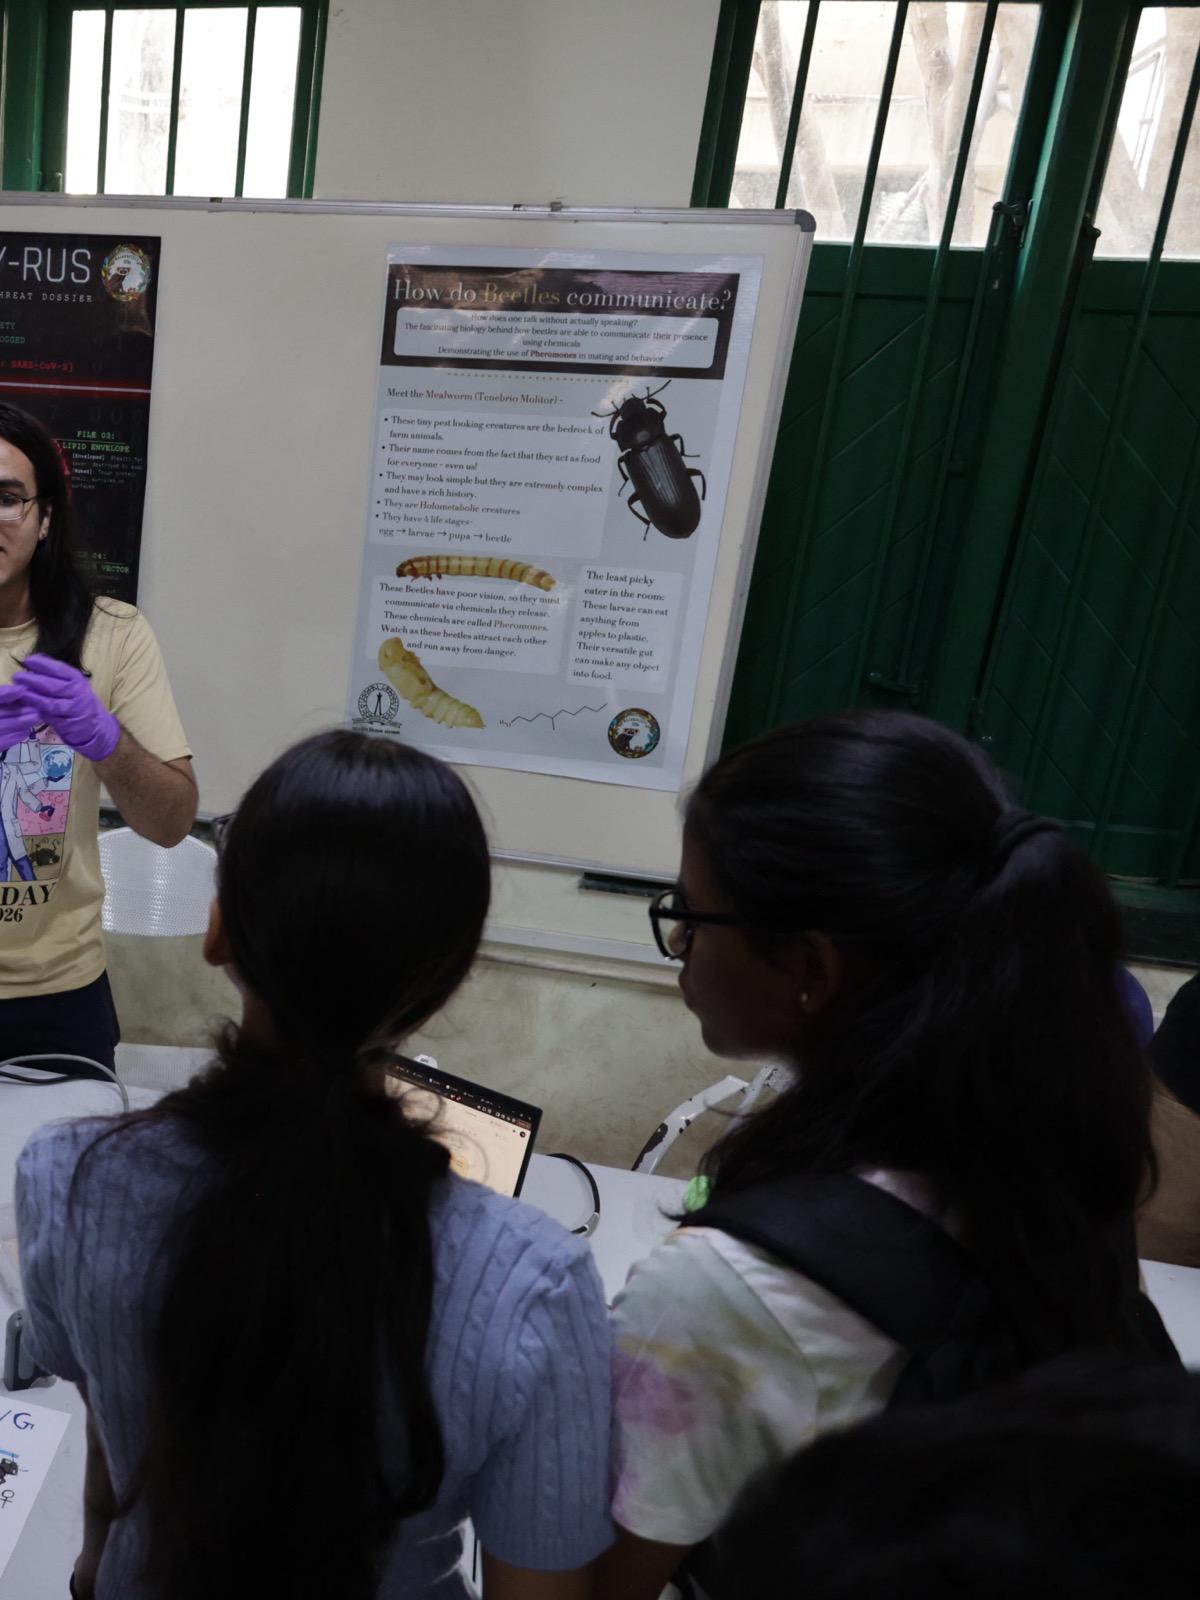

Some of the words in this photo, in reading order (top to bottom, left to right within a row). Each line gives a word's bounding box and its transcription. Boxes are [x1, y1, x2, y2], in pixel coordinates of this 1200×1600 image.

[42, 292, 92, 303] DOSSIER
[394, 282, 440, 301] How
[450, 283, 476, 302] do
[484, 284, 560, 304] Beetles
[567, 288, 732, 310] communicate?
[387, 387, 408, 397] Meet
[410, 388, 423, 397] the
[425, 389, 472, 400] Mealworm
[474, 391, 518, 402] (Tenebrio
[520, 393, 557, 404] Molitor)
[391, 415, 415, 424] These
[416, 418, 431, 426] tiny
[433, 420, 450, 429] pest
[452, 418, 484, 431] looking
[542, 423, 555, 432] the
[557, 423, 592, 433] bedrock
[594, 426, 604, 434] of
[389, 429, 408, 438] farm
[410, 431, 443, 440] animals.
[91, 444, 130, 453] ENVELOPE
[388, 443, 411, 452] Their
[464, 447, 484, 456] from
[486, 448, 498, 456] the
[500, 449, 515, 458] fact
[517, 450, 533, 459] that
[535, 452, 553, 461] they
[580, 454, 600, 463] food
[387, 457, 399, 465] for
[400, 460, 437, 470] everyone
[465, 462, 477, 470] us!
[385, 470, 405, 481] They
[426, 473, 443, 482] look
[445, 475, 472, 486] simple
[474, 476, 487, 484] but
[489, 477, 506, 487] they
[524, 481, 564, 490] extremely
[566, 483, 602, 494] complex
[384, 485, 399, 493] and
[401, 485, 420, 494] have
[428, 488, 444, 496] rich
[446, 488, 476, 498] history.
[384, 498, 402, 509] They
[419, 500, 479, 512] Holometabolic
[382, 511, 400, 522] They
[403, 513, 422, 521] have
[430, 515, 442, 523] life
[378, 528, 394, 537] egg
[408, 527, 434, 537] larvae
[448, 532, 470, 542] pupa
[485, 532, 511, 542] beetle
[586, 570, 603, 579] The
[605, 572, 627, 582] least
[628, 575, 655, 587] picky
[379, 582, 403, 592] These
[405, 584, 434, 594] Beetles
[435, 586, 455, 595] have
[456, 591, 477, 599] poor
[479, 591, 505, 600] vision,
[519, 593, 536, 602] they
[609, 588, 618, 596] in
[620, 588, 634, 597] the
[384, 599, 440, 608] communicate
[455, 603, 496, 613] chemicals
[498, 606, 515, 616] they
[582, 600, 607, 609] These
[609, 602, 636, 612] larvae
[580, 615, 616, 627] anything
[618, 617, 639, 627] from
[578, 629, 606, 639] apples
[617, 632, 647, 642] plastic.
[576, 641, 600, 651] Their
[601, 646, 637, 654] versatile
[638, 649, 652, 658] gut
[616, 662, 630, 670] any
[632, 661, 658, 672] object
[590, 670, 612, 679] food.
[1, 882, 58, 906] DAY
